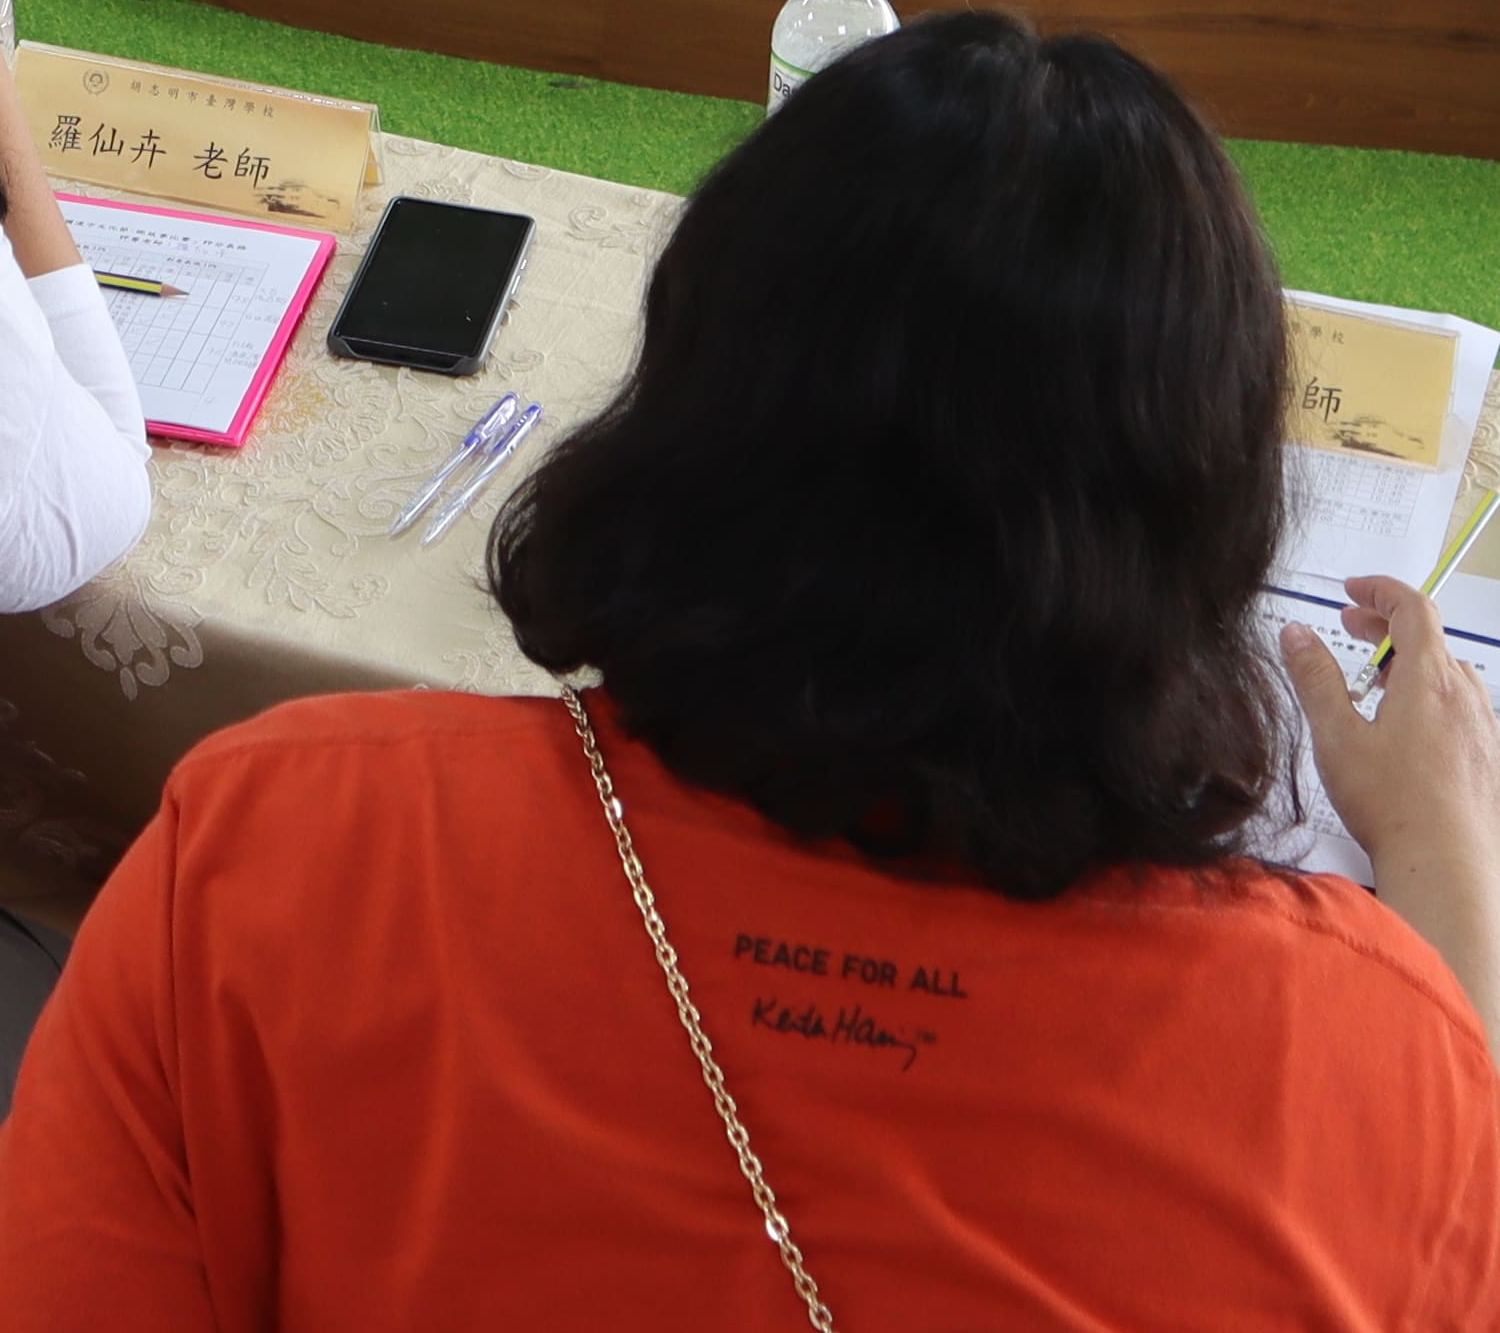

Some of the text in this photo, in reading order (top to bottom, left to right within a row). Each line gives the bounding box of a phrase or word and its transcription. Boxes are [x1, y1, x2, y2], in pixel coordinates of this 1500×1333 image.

[131, 80, 276, 119] 胡志明市臺灣學校
[48, 114, 272, 190] 羅仙卉 老師
[1302, 376, 1342, 424] 師
[734, 935, 968, 999] PEACE FOR ALL
